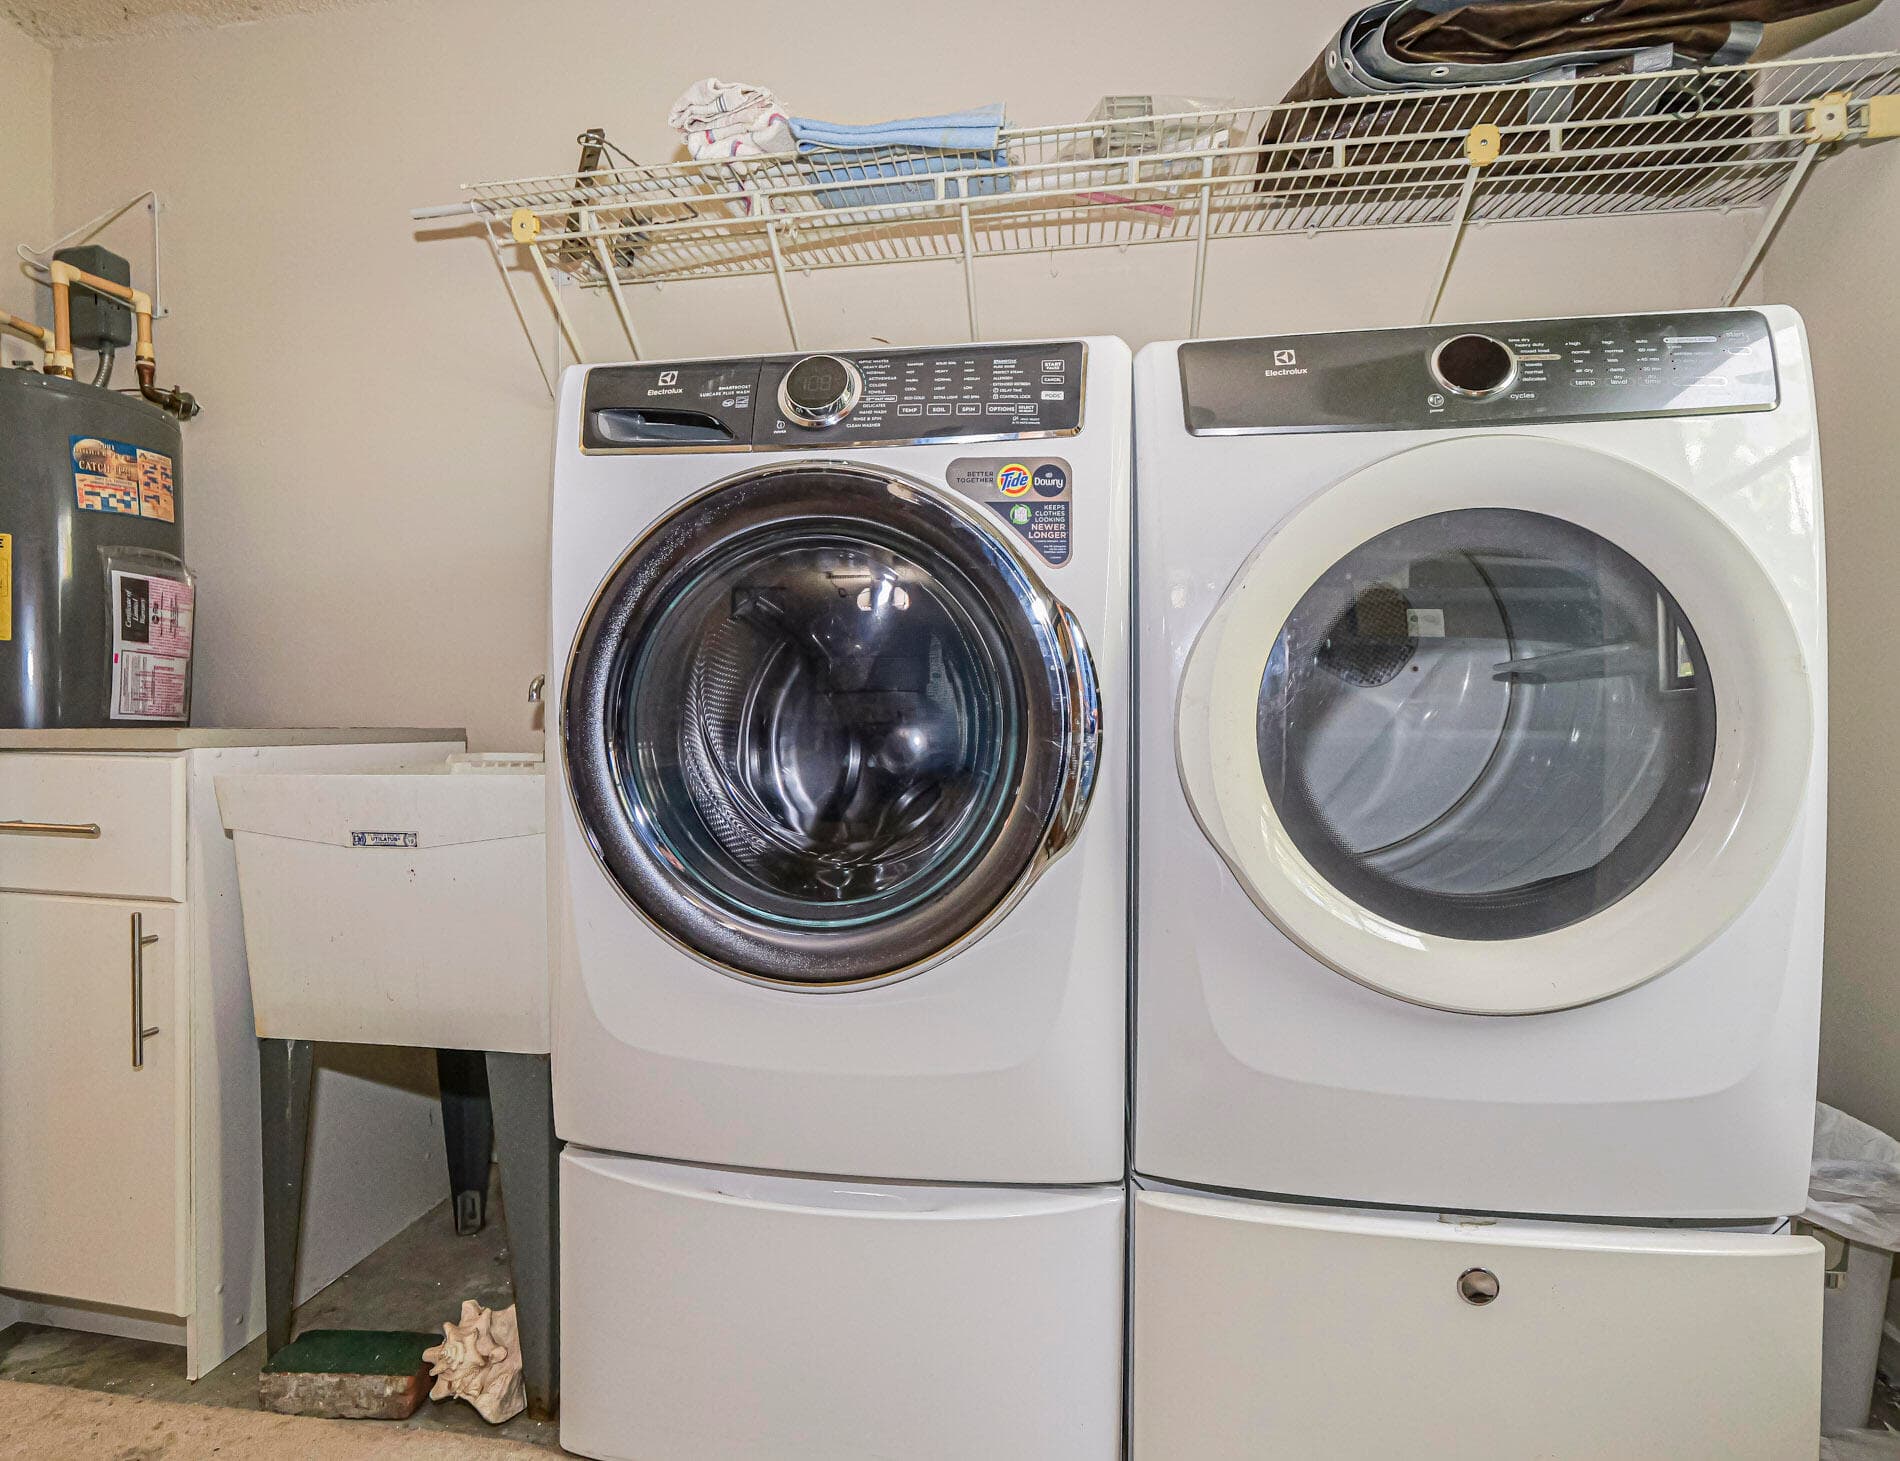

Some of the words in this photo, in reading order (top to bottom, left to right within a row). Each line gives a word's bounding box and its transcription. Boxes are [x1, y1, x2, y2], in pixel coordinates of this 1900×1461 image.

[1265, 367, 1308, 377] Electrolux
[1575, 379, 1596, 387] temp
[647, 388, 684, 396] Electrolux
[1510, 392, 1536, 400] cycles
[1000, 470, 1029, 492] Tide
[1034, 477, 1064, 489] Downy
[1031, 523, 1066, 531] NEWER
[1028, 531, 1067, 539] LONGER
